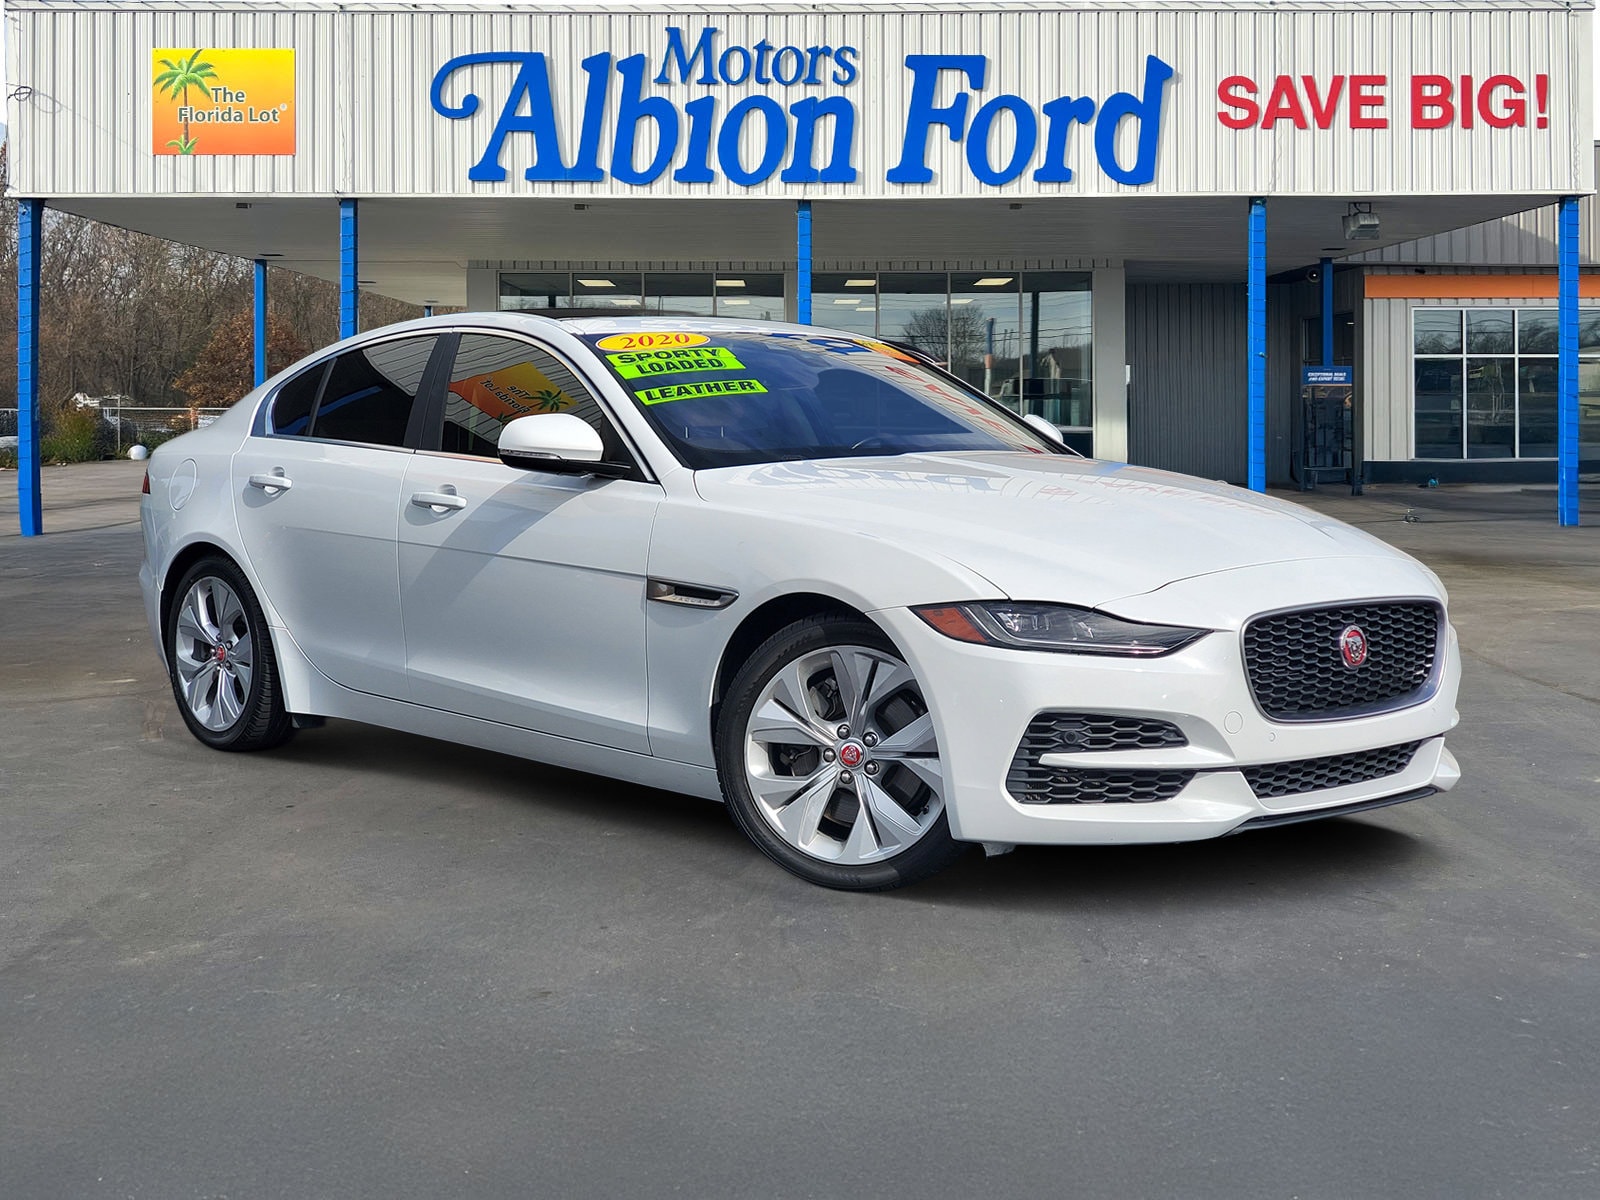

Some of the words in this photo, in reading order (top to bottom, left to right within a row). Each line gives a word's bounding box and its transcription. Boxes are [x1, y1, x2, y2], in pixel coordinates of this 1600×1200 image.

[655, 27, 857, 85] Motors
[211, 86, 246, 103] The
[1217, 75, 1388, 129] SAVE
[1411, 74, 1549, 129] BIG!
[178, 106, 243, 122] Florida
[248, 107, 279, 122] Lot
[430, 52, 857, 186] Albion
[886, 55, 1176, 186] Ford
[620, 333, 690, 349] 2020
[617, 348, 718, 364] SPORTY
[636, 358, 724, 374] LOADED
[645, 380, 755, 402] LEATHER
